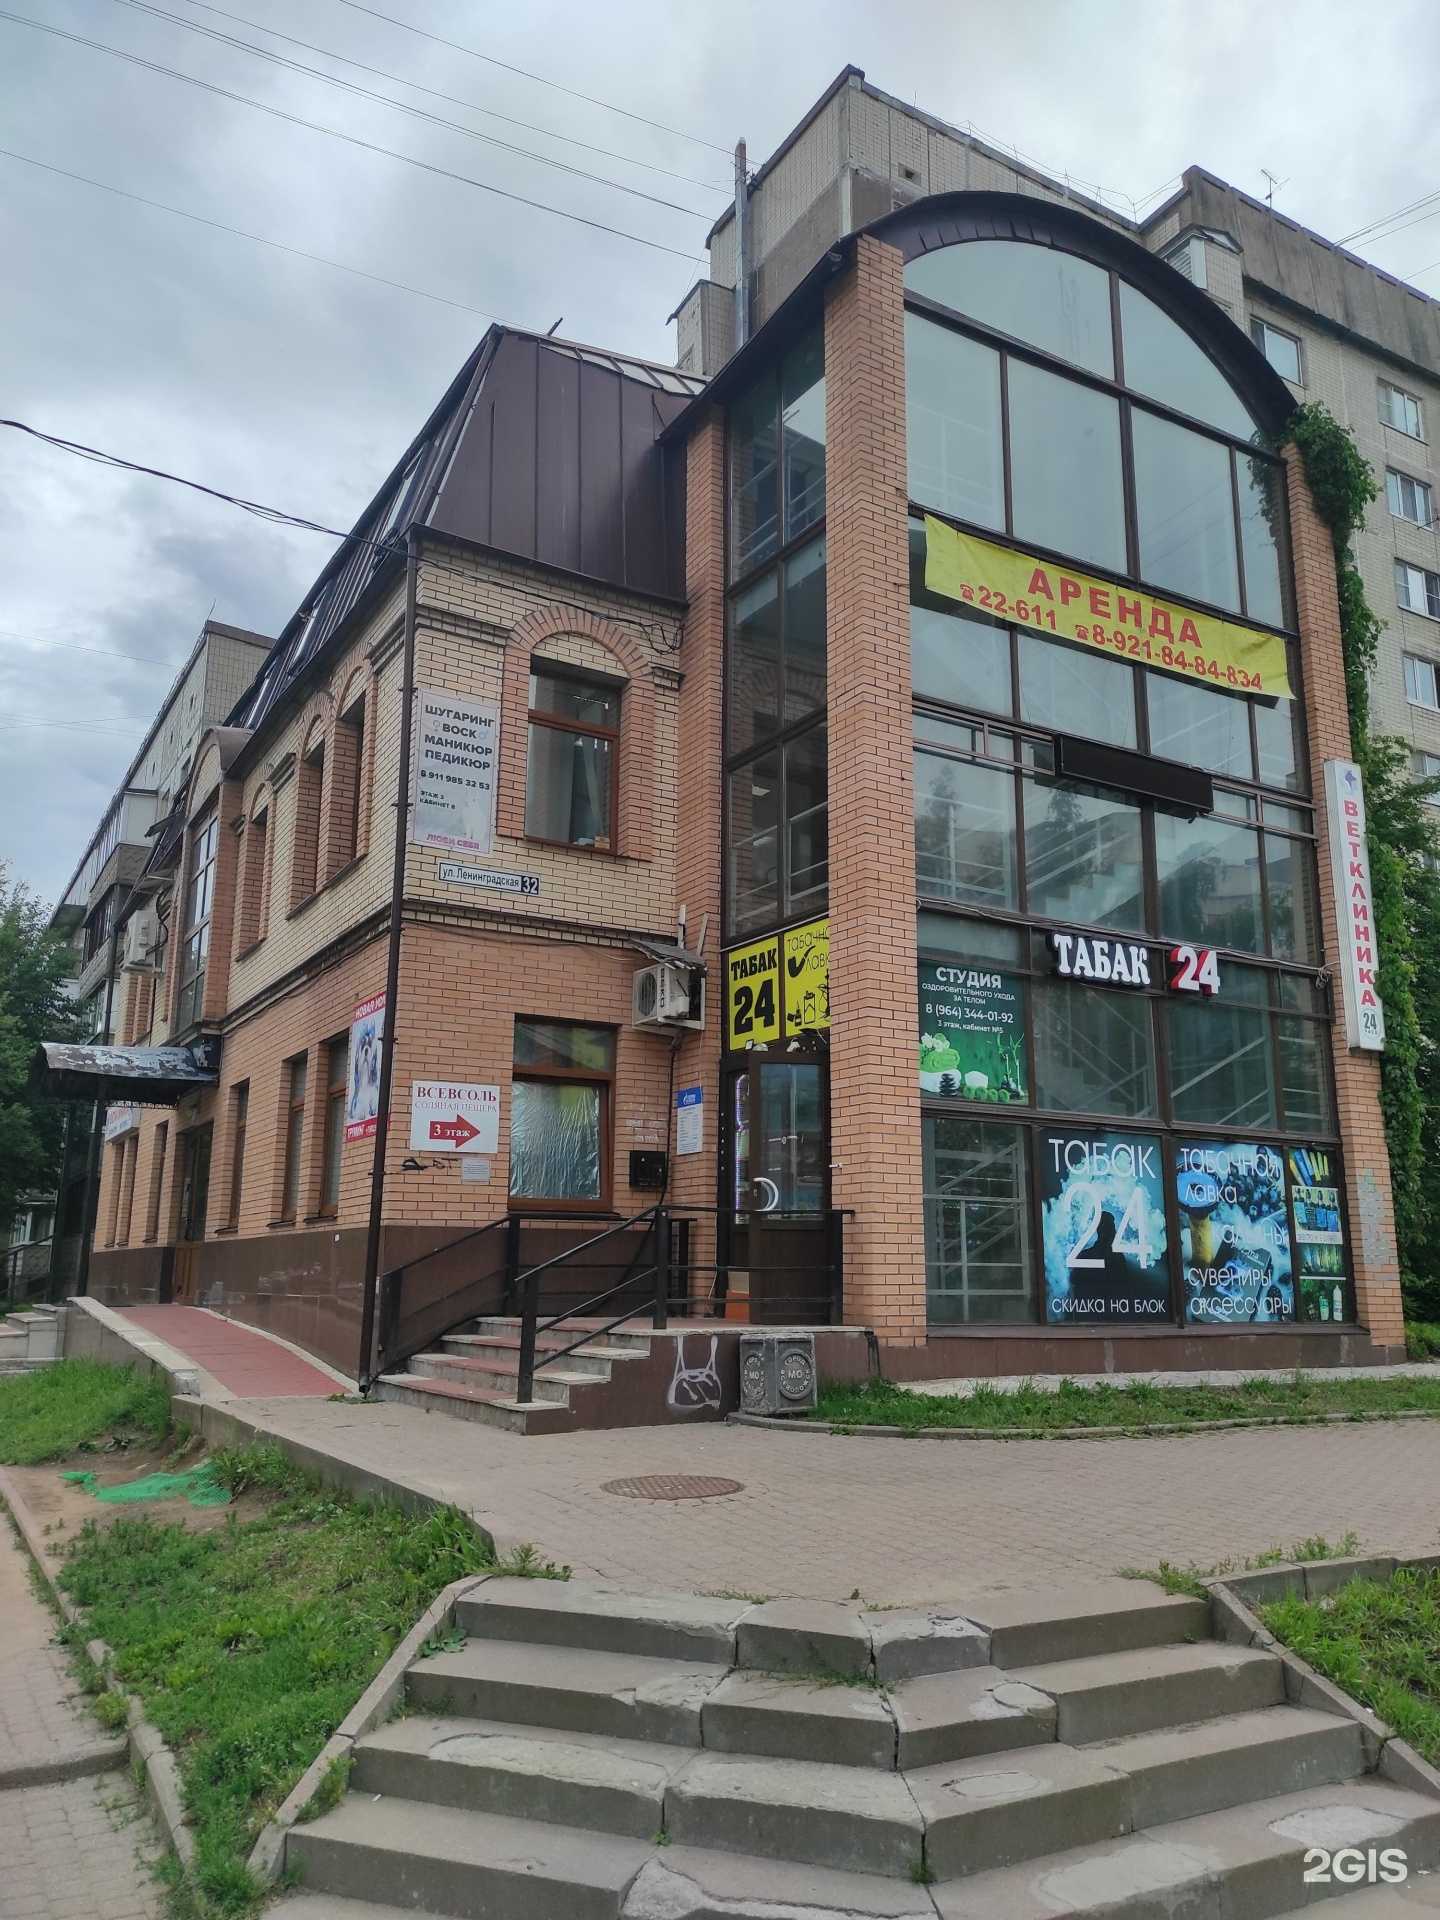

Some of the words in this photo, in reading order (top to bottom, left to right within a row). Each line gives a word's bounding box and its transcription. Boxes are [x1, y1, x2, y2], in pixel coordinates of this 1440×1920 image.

[978, 585, 1057, 630] 22-611
[1027, 566, 1202, 648] АРЕНДА
[1092, 624, 1263, 690] 8-921-84-84-834
[425, 704, 495, 728] ШУГАРИНГ
[442, 723, 478, 739] ВОСК
[424, 734, 493, 757] МАНИКЮР
[424, 749, 491, 770] ПЕДИКЮР
[428, 771, 444, 780] 911
[446, 775, 463, 785] 985
[419, 797, 450, 809] КАБИНЕТ
[420, 790, 439, 799] ЭТАЖ
[443, 866, 455, 879] ул.
[457, 868, 519, 888] Ленинградская
[522, 876, 538, 893] 32
[1344, 799, 1376, 1007] ВЕТКЛИНИКА
[731, 947, 778, 982] ТАБАК
[1053, 933, 1151, 985] ТАБАК
[1171, 945, 1221, 995] 24
[936, 967, 1002, 989] СТУДИЯ
[921, 982, 993, 999] ОЗДОРОВИТЕЛЬНОГО
[993, 992, 1016, 1001] УХОДА
[953, 994, 962, 1003] ЗА
[963, 996, 986, 1005] ТЕЛОМ
[734, 978, 776, 1036] 24
[926, 1003, 933, 1014] 8
[935, 1004, 962, 1020] (964)
[963, 1008, 1014, 1024] 344-01-92
[962, 1023, 990, 1033] кабинет
[1363, 1012, 1377, 1030] 24
[417, 1086, 497, 1102] ВСЕВСОЛЬ
[433, 1124, 441, 1136] 3
[444, 1128, 471, 1137] этаж
[1065, 1183, 1153, 1270] 24
